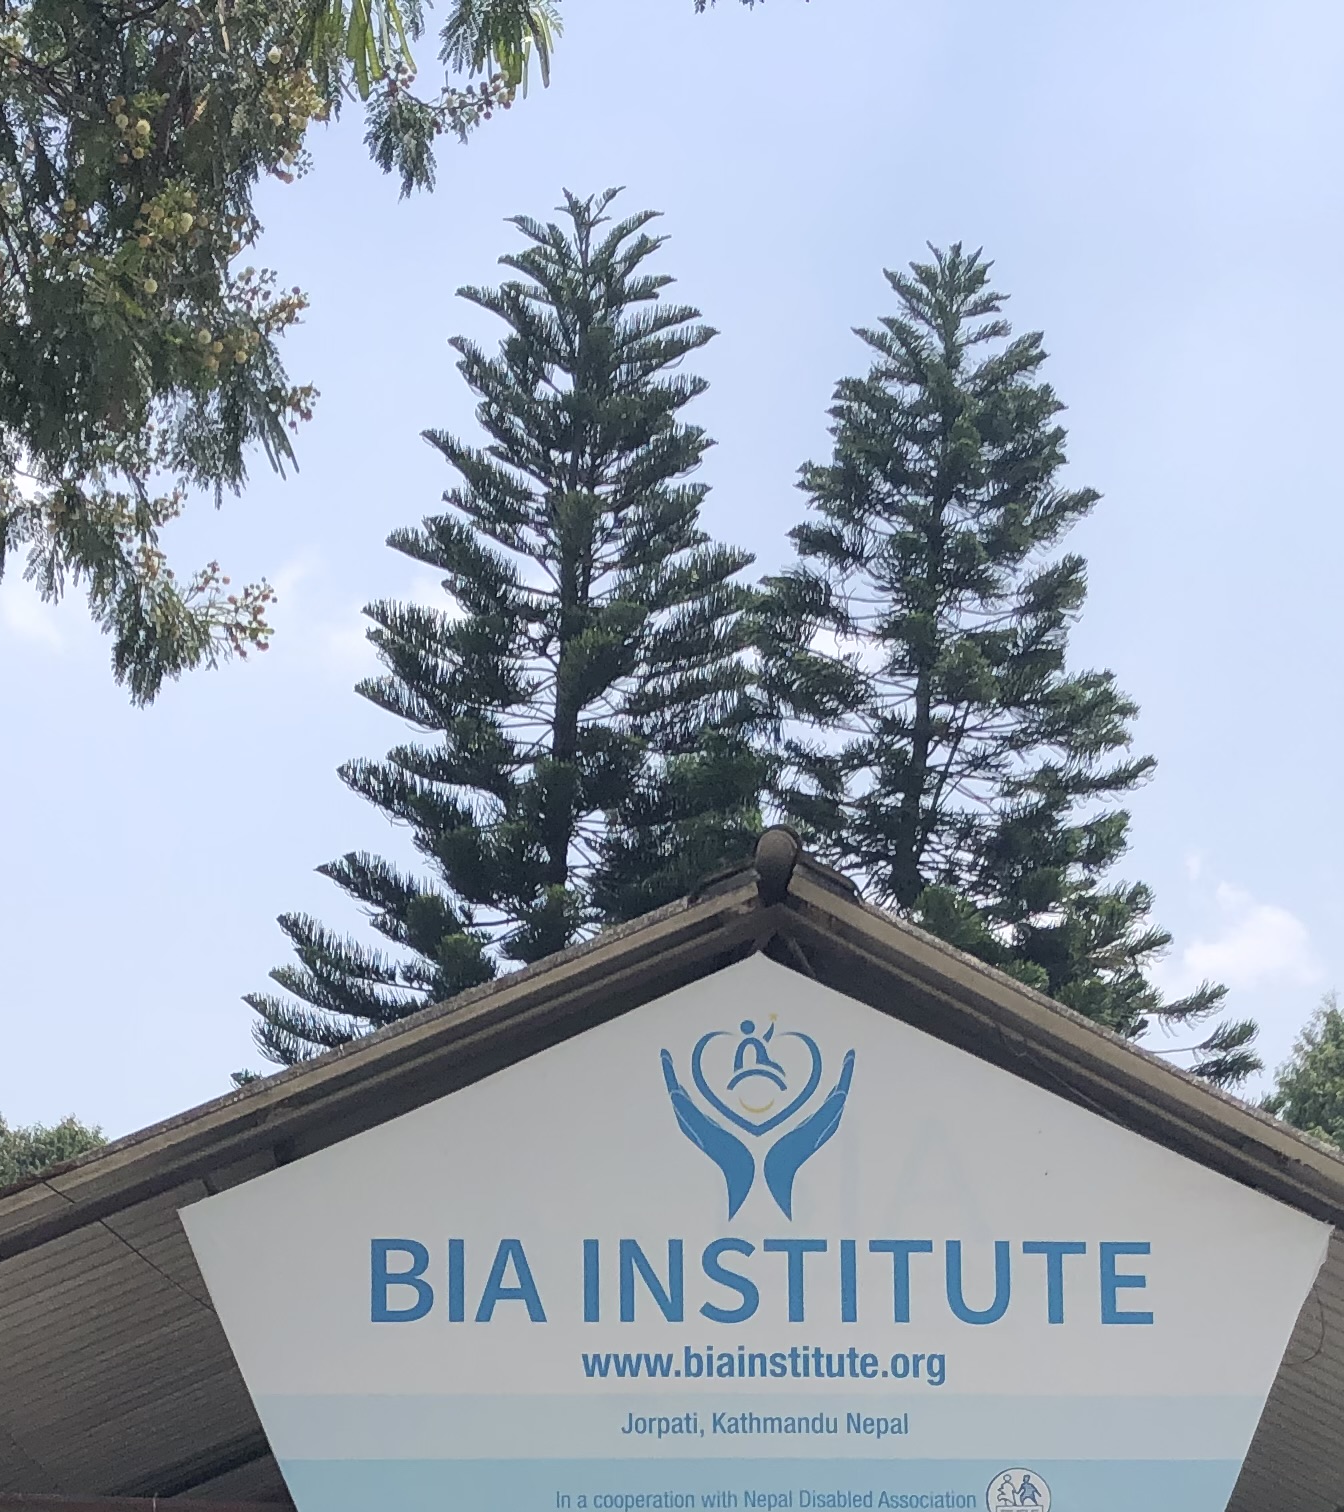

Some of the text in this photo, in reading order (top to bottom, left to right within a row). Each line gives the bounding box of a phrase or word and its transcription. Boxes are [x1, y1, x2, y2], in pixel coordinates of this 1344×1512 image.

[370, 1237, 1156, 1327] BIA INSTITUTE
[581, 1345, 948, 1388] www.biainstitute.org
[621, 1412, 909, 1440] Jorpati, Kathmandu Nepal
[556, 1489, 978, 1512] In a cooperation with Nepal Disabled Association
